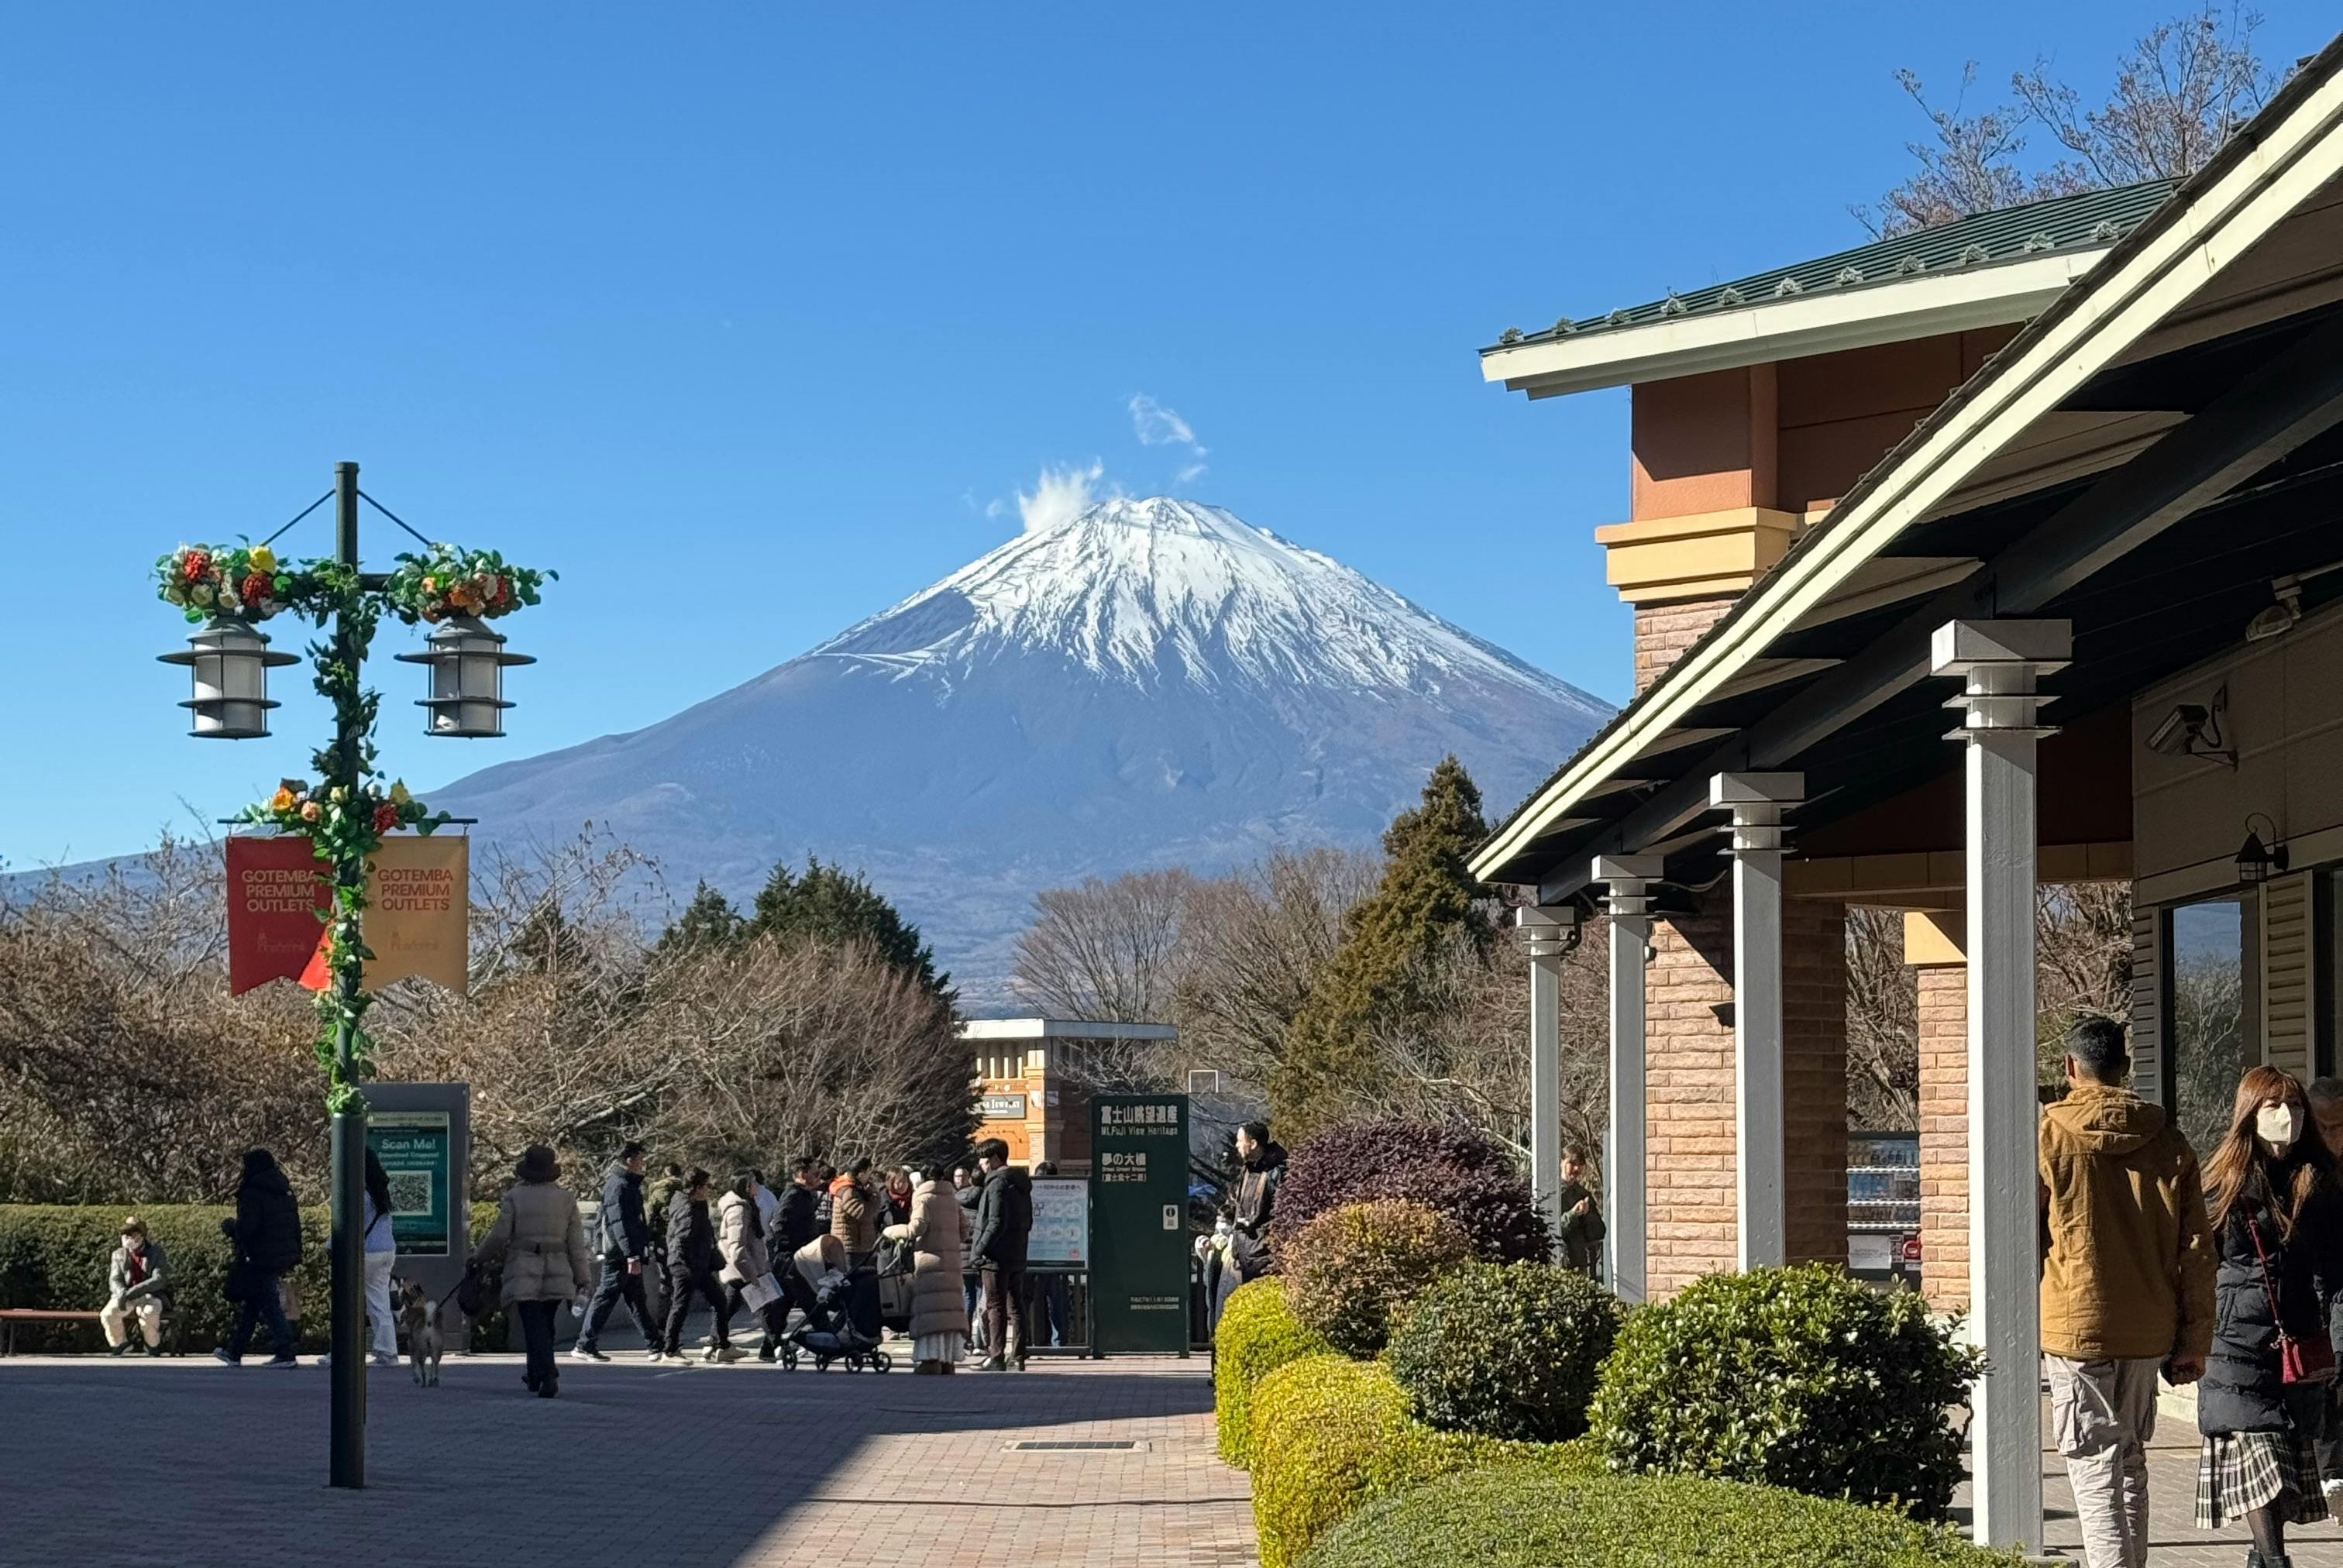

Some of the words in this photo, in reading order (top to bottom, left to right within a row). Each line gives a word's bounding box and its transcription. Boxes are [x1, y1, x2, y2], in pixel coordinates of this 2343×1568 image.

[242, 870, 315, 882] GOTEMBA
[377, 868, 454, 882] GOTEMBA
[246, 884, 315, 897] PREMIUM
[381, 883, 449, 896] PREMIUM
[246, 899, 315, 912] OUTLETS
[381, 898, 450, 910] OUTLETS
[1101, 1105, 1178, 1124] 富士山眺望遺産
[381, 1138, 410, 1149] Scan
[413, 1138, 436, 1150] Me!
